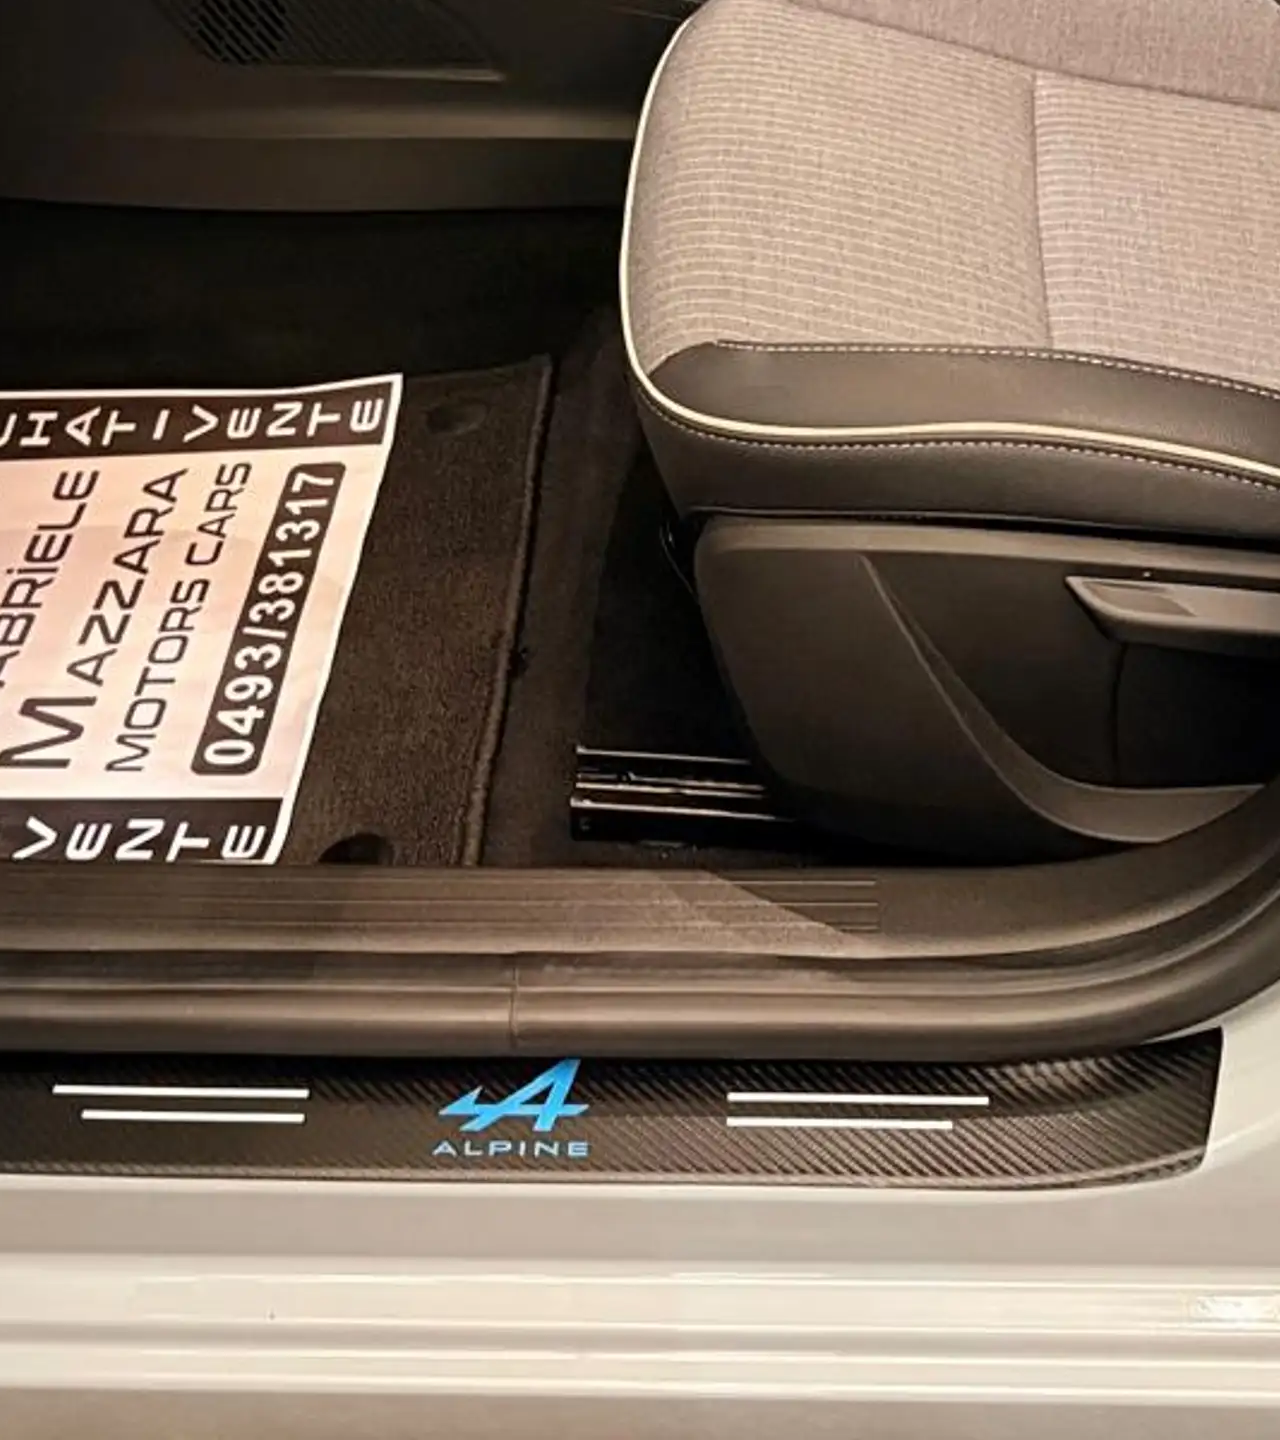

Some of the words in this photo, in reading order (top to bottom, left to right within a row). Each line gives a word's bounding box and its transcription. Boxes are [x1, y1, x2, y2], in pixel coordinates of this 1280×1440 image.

[104, 577, 212, 772] MOTORS
[184, 462, 253, 567] CARS
[203, 472, 335, 766] 0493/381317
[431, 1138, 590, 1158] ALPINE
